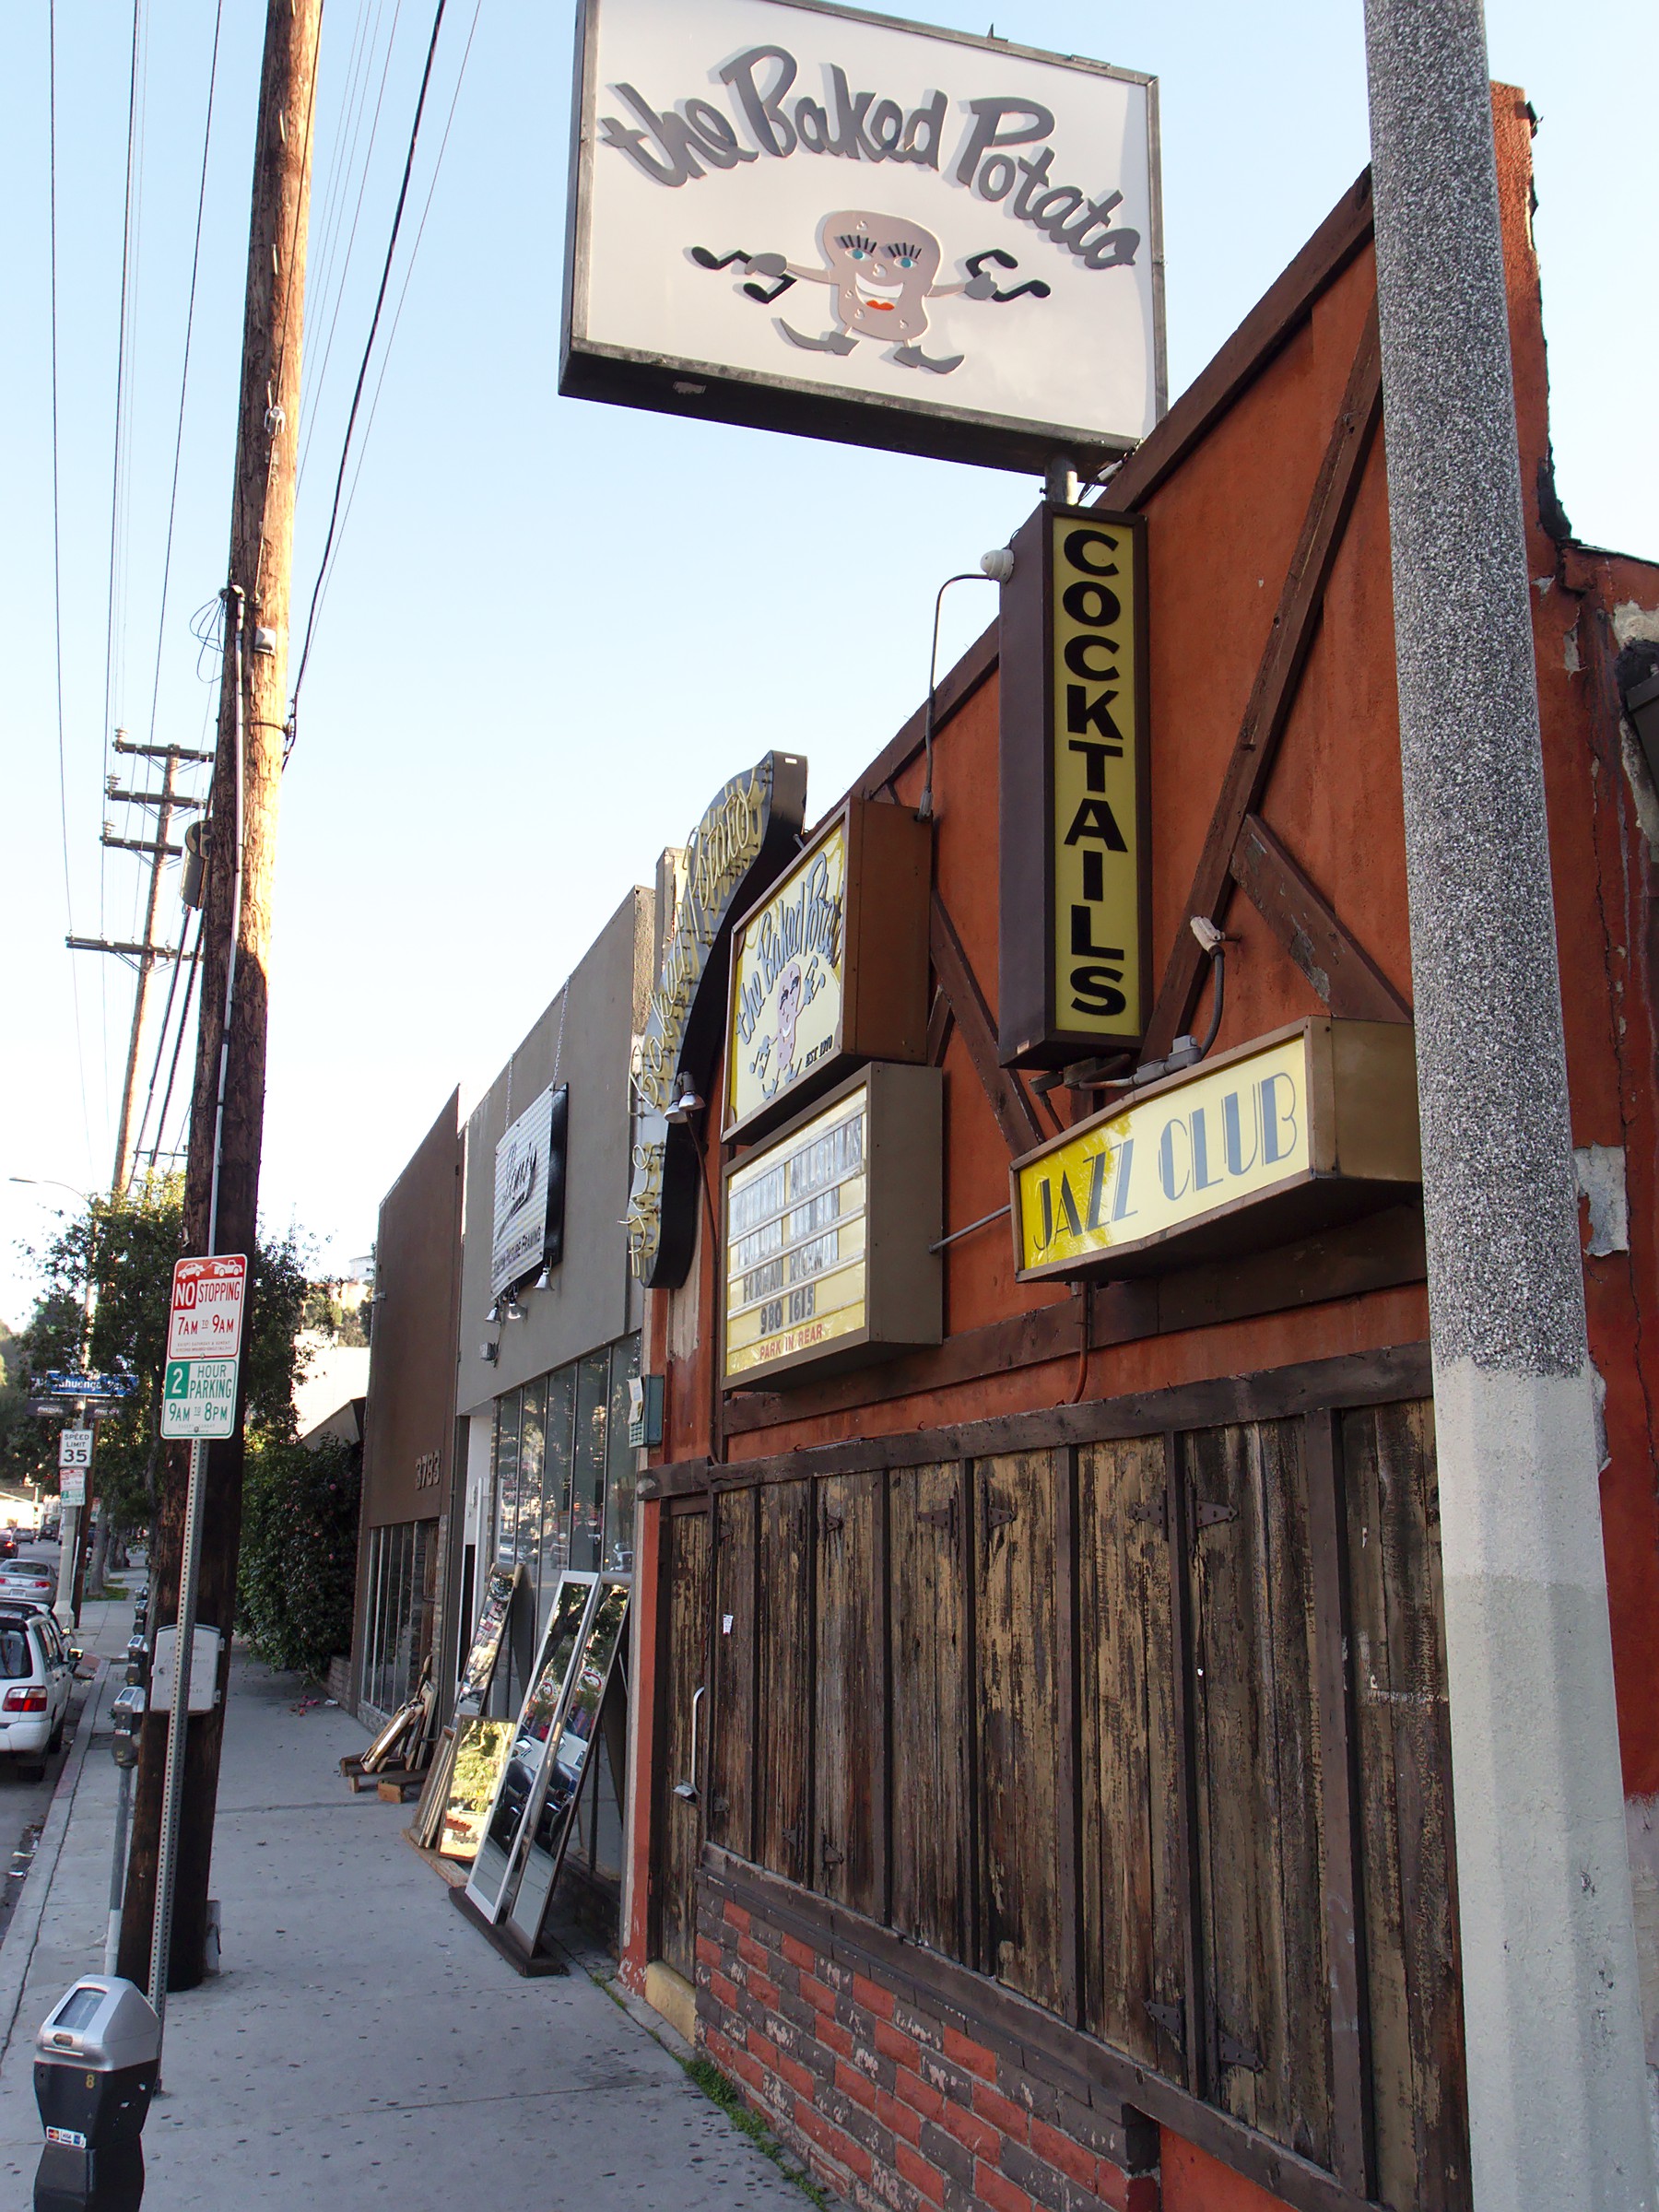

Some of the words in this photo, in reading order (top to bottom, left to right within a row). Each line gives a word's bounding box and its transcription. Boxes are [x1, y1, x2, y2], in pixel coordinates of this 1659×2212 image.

[602, 83, 759, 187] the
[720, 44, 948, 172] Baked
[955, 96, 1141, 270] Potato
[1063, 528, 1127, 1017] COCKTAILS
[682, 767, 768, 944] Potato
[735, 977, 767, 1045] the
[757, 881, 806, 994] Baked
[806, 1046, 818, 1067] EST
[1033, 1138, 1138, 1252] JAZZ
[1158, 1072, 1298, 1201] CLUB
[175, 1281, 196, 1307] NO
[198, 1281, 241, 1302] STOPPING
[760, 1299, 782, 1335] 980
[789, 1286, 814, 1324] 1615
[178, 1316, 198, 1335] 7AM
[212, 1314, 234, 1333] 9AM
[759, 1342, 782, 1359] PARK
[785, 1336, 794, 1351] IN
[798, 1324, 823, 1346] REAR
[171, 1368, 183, 1394] 2
[197, 1365, 227, 1378] HOUR
[57, 1378, 102, 1392] ahuenga
[189, 1379, 232, 1399] PARKING
[169, 1403, 190, 1421] 9AM
[205, 1402, 228, 1421] 8PM
[64, 1449, 88, 1463] 35
